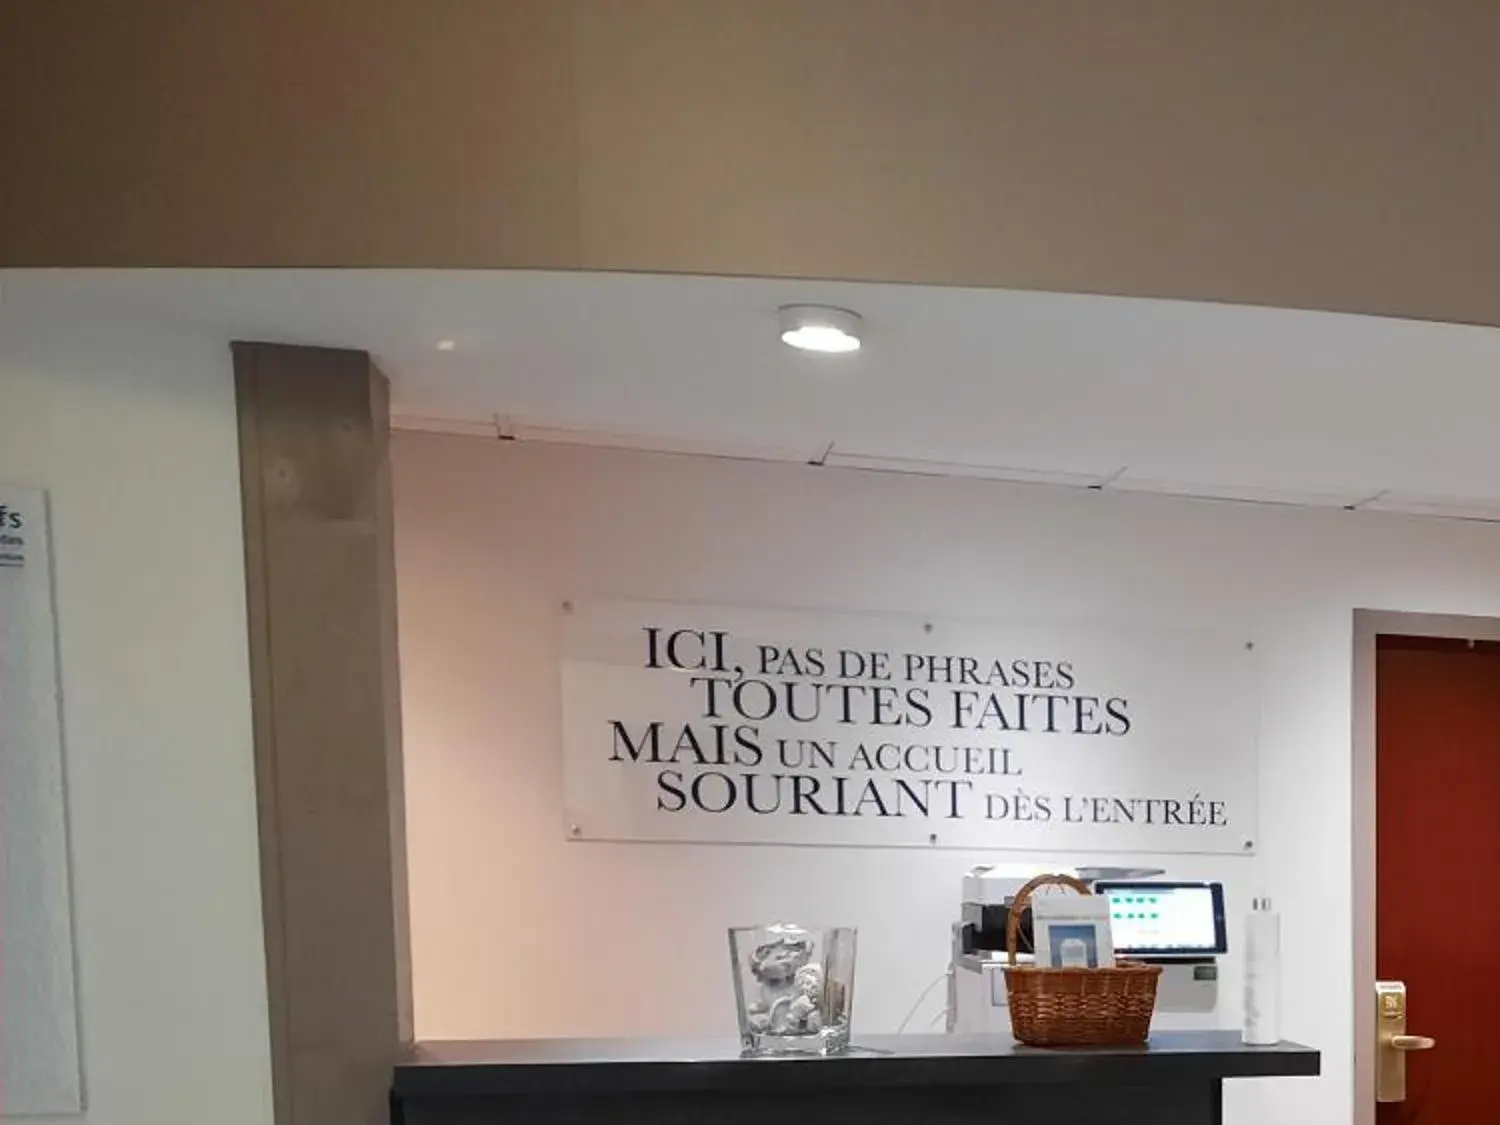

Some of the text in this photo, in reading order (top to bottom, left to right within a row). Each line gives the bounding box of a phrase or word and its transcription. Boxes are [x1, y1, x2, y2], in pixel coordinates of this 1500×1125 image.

[641, 626, 1076, 690] ICI, PAS DE PHRASES
[690, 676, 1131, 736] TOUTES FAITES
[607, 719, 1023, 776] MAIS UN ACCUEIL
[656, 769, 1228, 826] SOURIANT DÈS L'ENTRÉE
